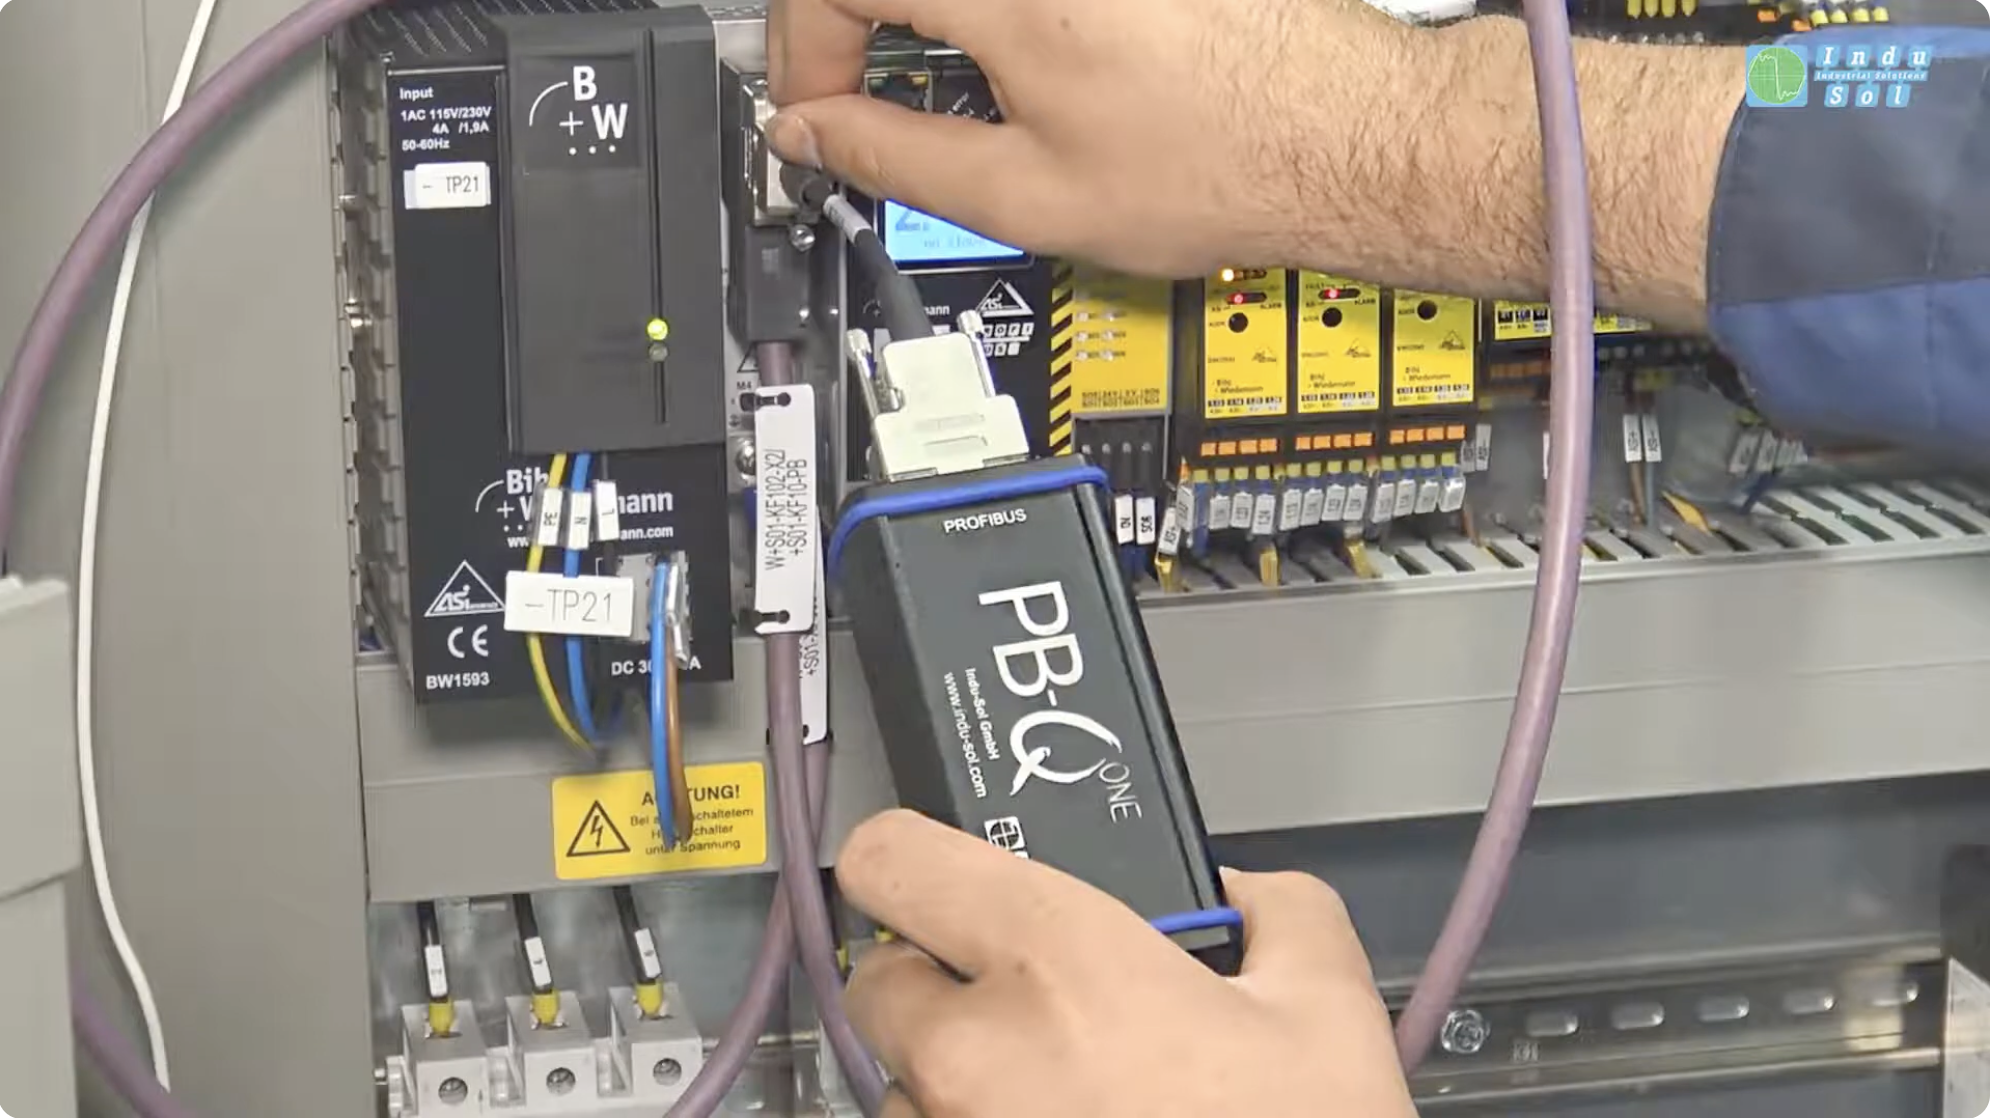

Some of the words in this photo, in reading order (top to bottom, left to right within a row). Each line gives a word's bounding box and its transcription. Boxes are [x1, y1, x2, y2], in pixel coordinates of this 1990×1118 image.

[573, 65, 597, 101] B
[399, 87, 434, 101] Input
[400, 108, 426, 121] 1AC
[429, 105, 492, 119] 115V/230V
[432, 122, 449, 134] 4A
[401, 137, 451, 151] 50-60Hz
[446, 175, 480, 194] TP21
[507, 467, 550, 495] Bih
[943, 508, 1027, 533] PROFIBUS
[611, 660, 634, 676] DC
[426, 671, 491, 690] BW1593
[978, 581, 1122, 796] PB-Q
[1098, 761, 1143, 824] ONE
[965, 667, 989, 719] Indu-Sol
[979, 720, 1001, 761] GmbH
[943, 671, 987, 799] www.indu-sol.com
[630, 815, 649, 826] Bei
